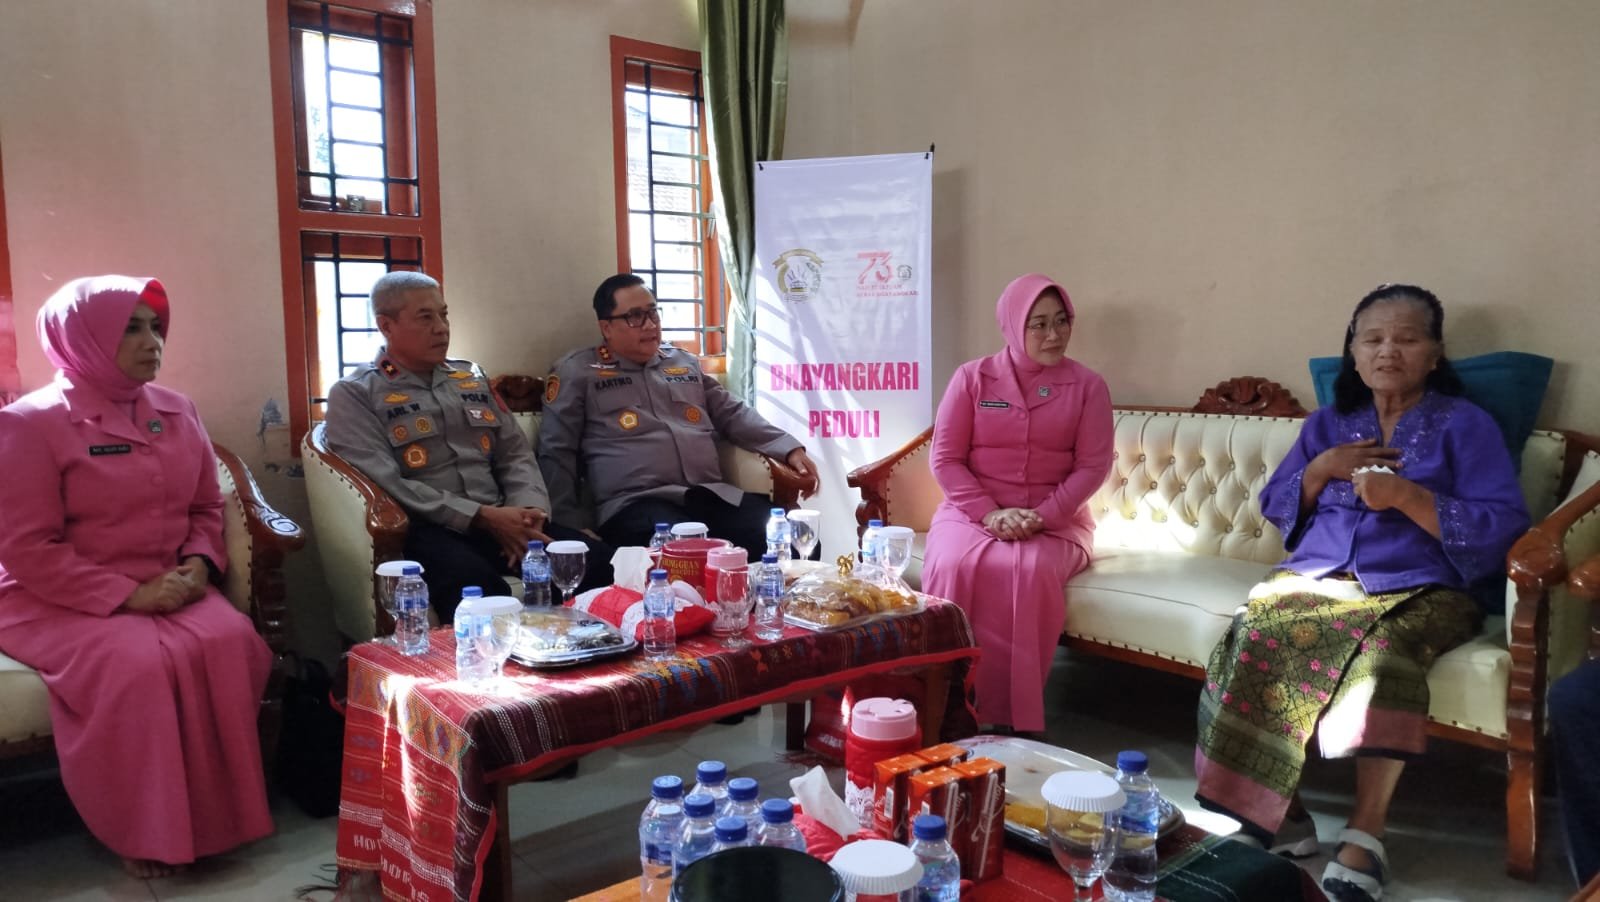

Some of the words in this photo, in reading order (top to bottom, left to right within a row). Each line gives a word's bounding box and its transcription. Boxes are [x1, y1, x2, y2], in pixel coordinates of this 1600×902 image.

[857, 251, 893, 284] 73
[666, 375, 699, 383] POLRI
[770, 362, 919, 391] BHAYANGKARI
[808, 410, 880, 438] PEDULI
